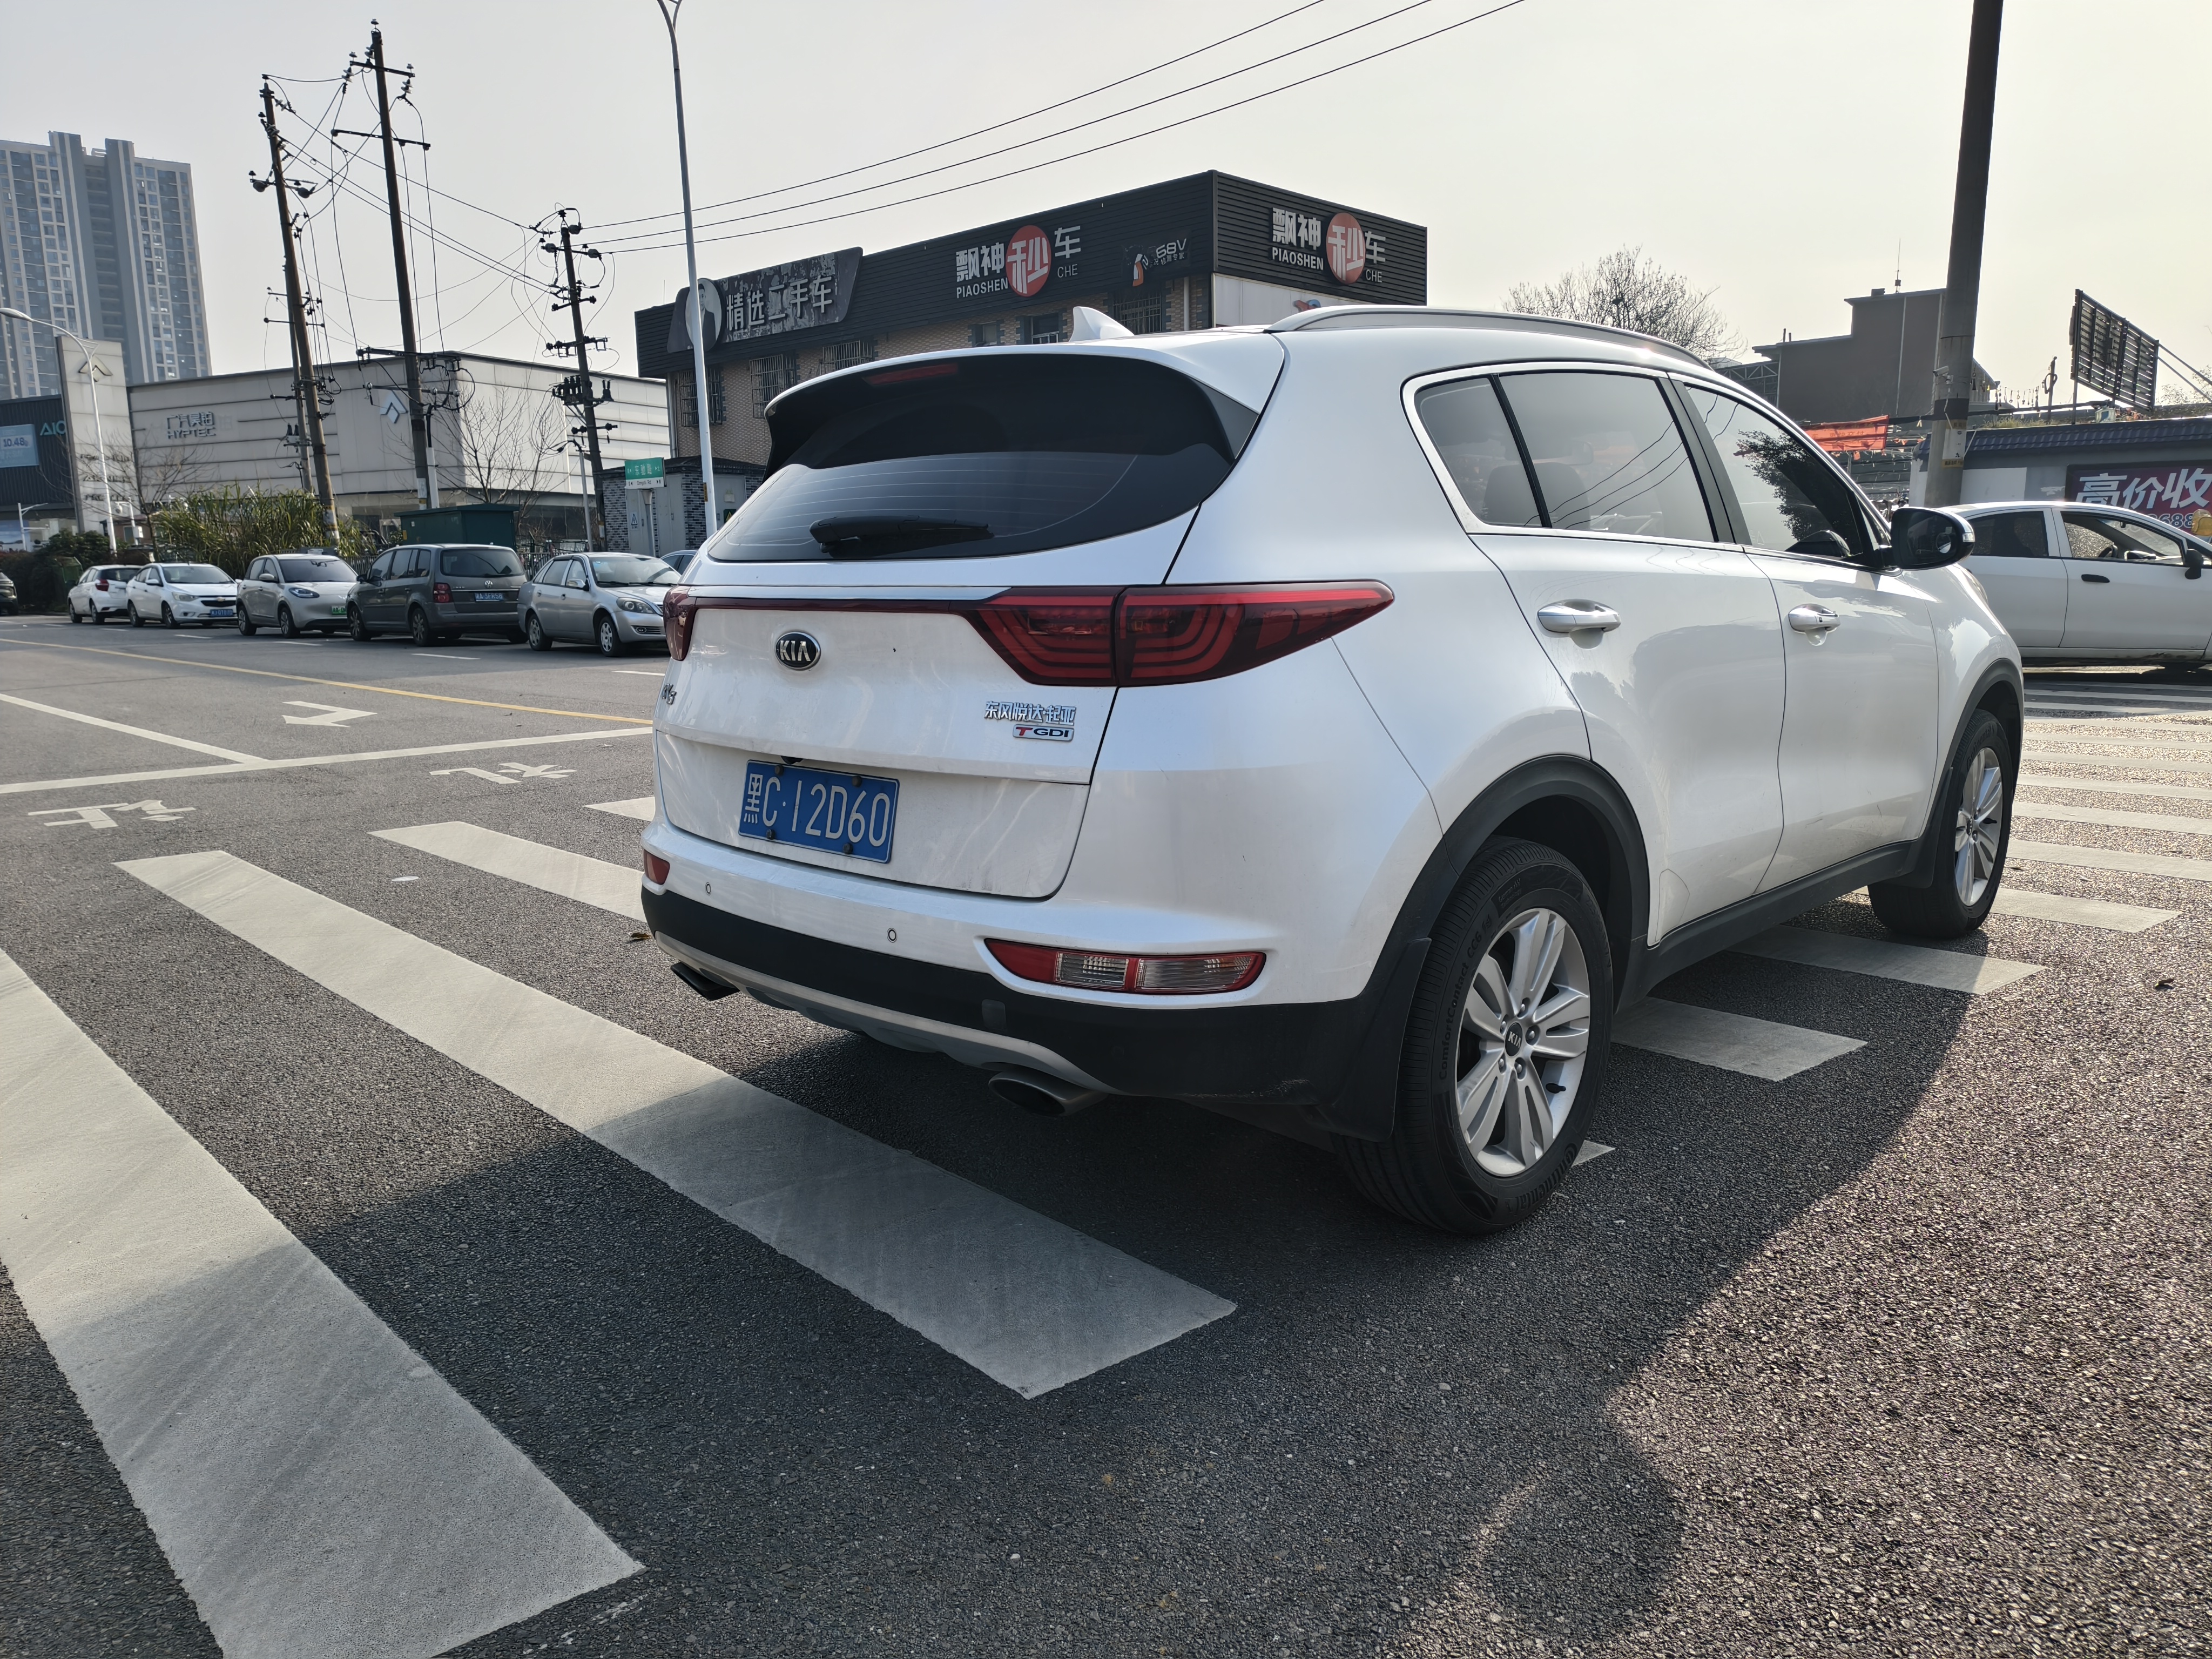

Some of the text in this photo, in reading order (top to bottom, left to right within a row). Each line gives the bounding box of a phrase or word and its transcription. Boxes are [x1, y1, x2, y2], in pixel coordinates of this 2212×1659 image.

[956, 226, 1081, 294] 飘神秒车
[1272, 207, 1386, 281] 飘神秒车
[956, 264, 1078, 298] PIAOSHEN CHE
[1272, 247, 1382, 282] PIAOSHEN CHE
[726, 275, 832, 331] 精选二手车
[167, 427, 216, 439] HYPTEC
[2076, 468, 2212, 509] 高价收
[2146, 513, 2193, 528] 688
[780, 640, 811, 662] KIA
[1439, 930, 1482, 1080] ComfortContact CC6
[1508, 1031, 1521, 1048] KIA
